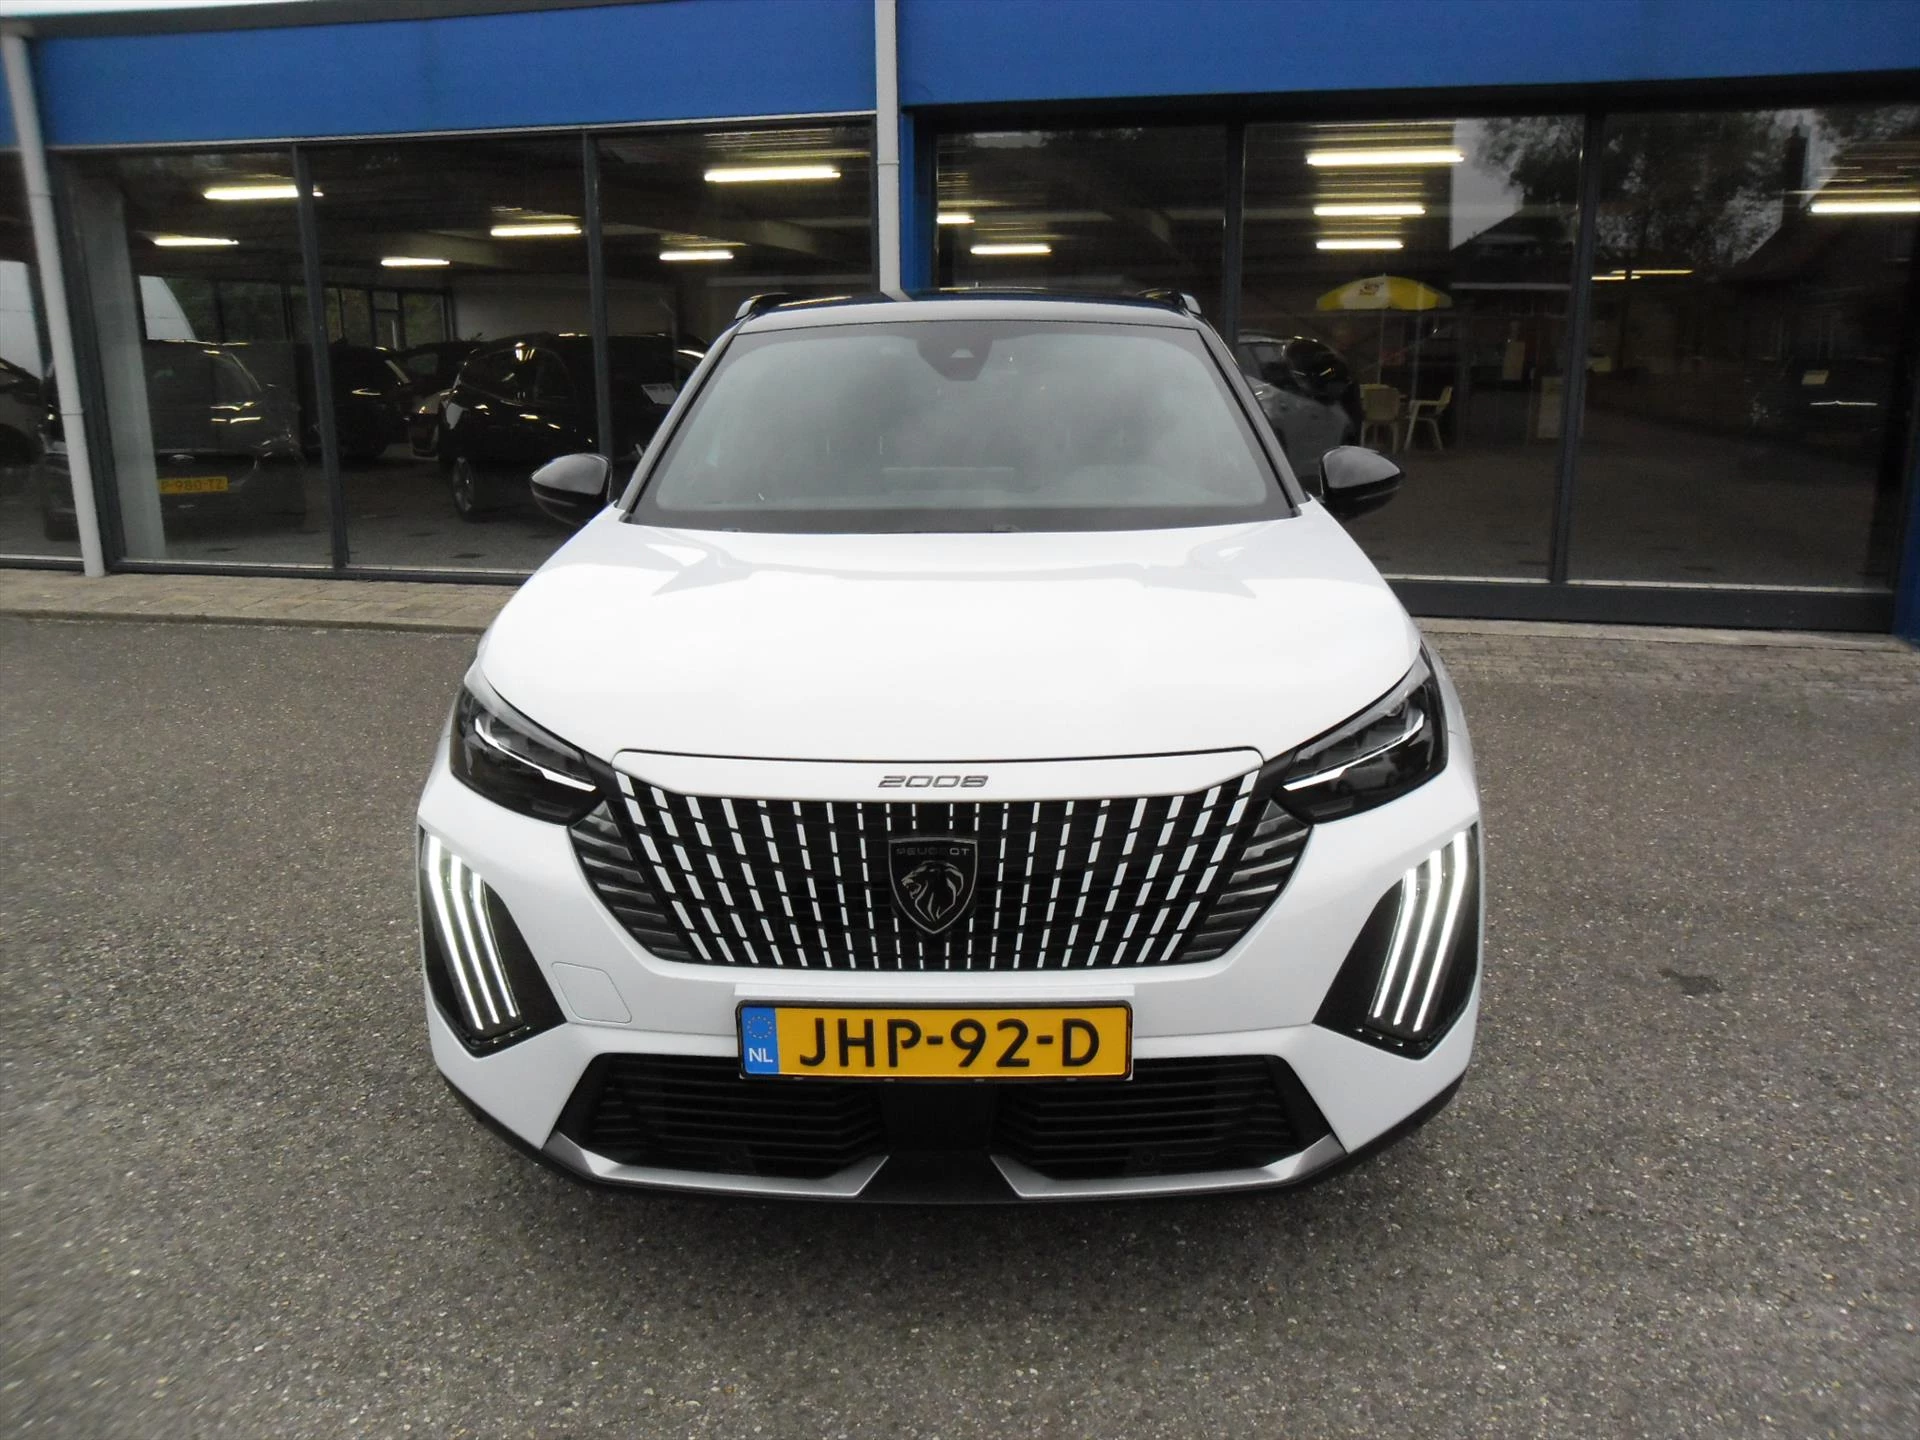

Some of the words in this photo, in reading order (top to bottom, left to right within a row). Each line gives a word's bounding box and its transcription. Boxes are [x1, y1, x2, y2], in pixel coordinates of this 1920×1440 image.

[878, 775, 988, 788] 2008
[896, 847, 970, 856] PEUGOT
[799, 1017, 1100, 1068] JHP-92-D
[749, 1047, 773, 1063] NL
